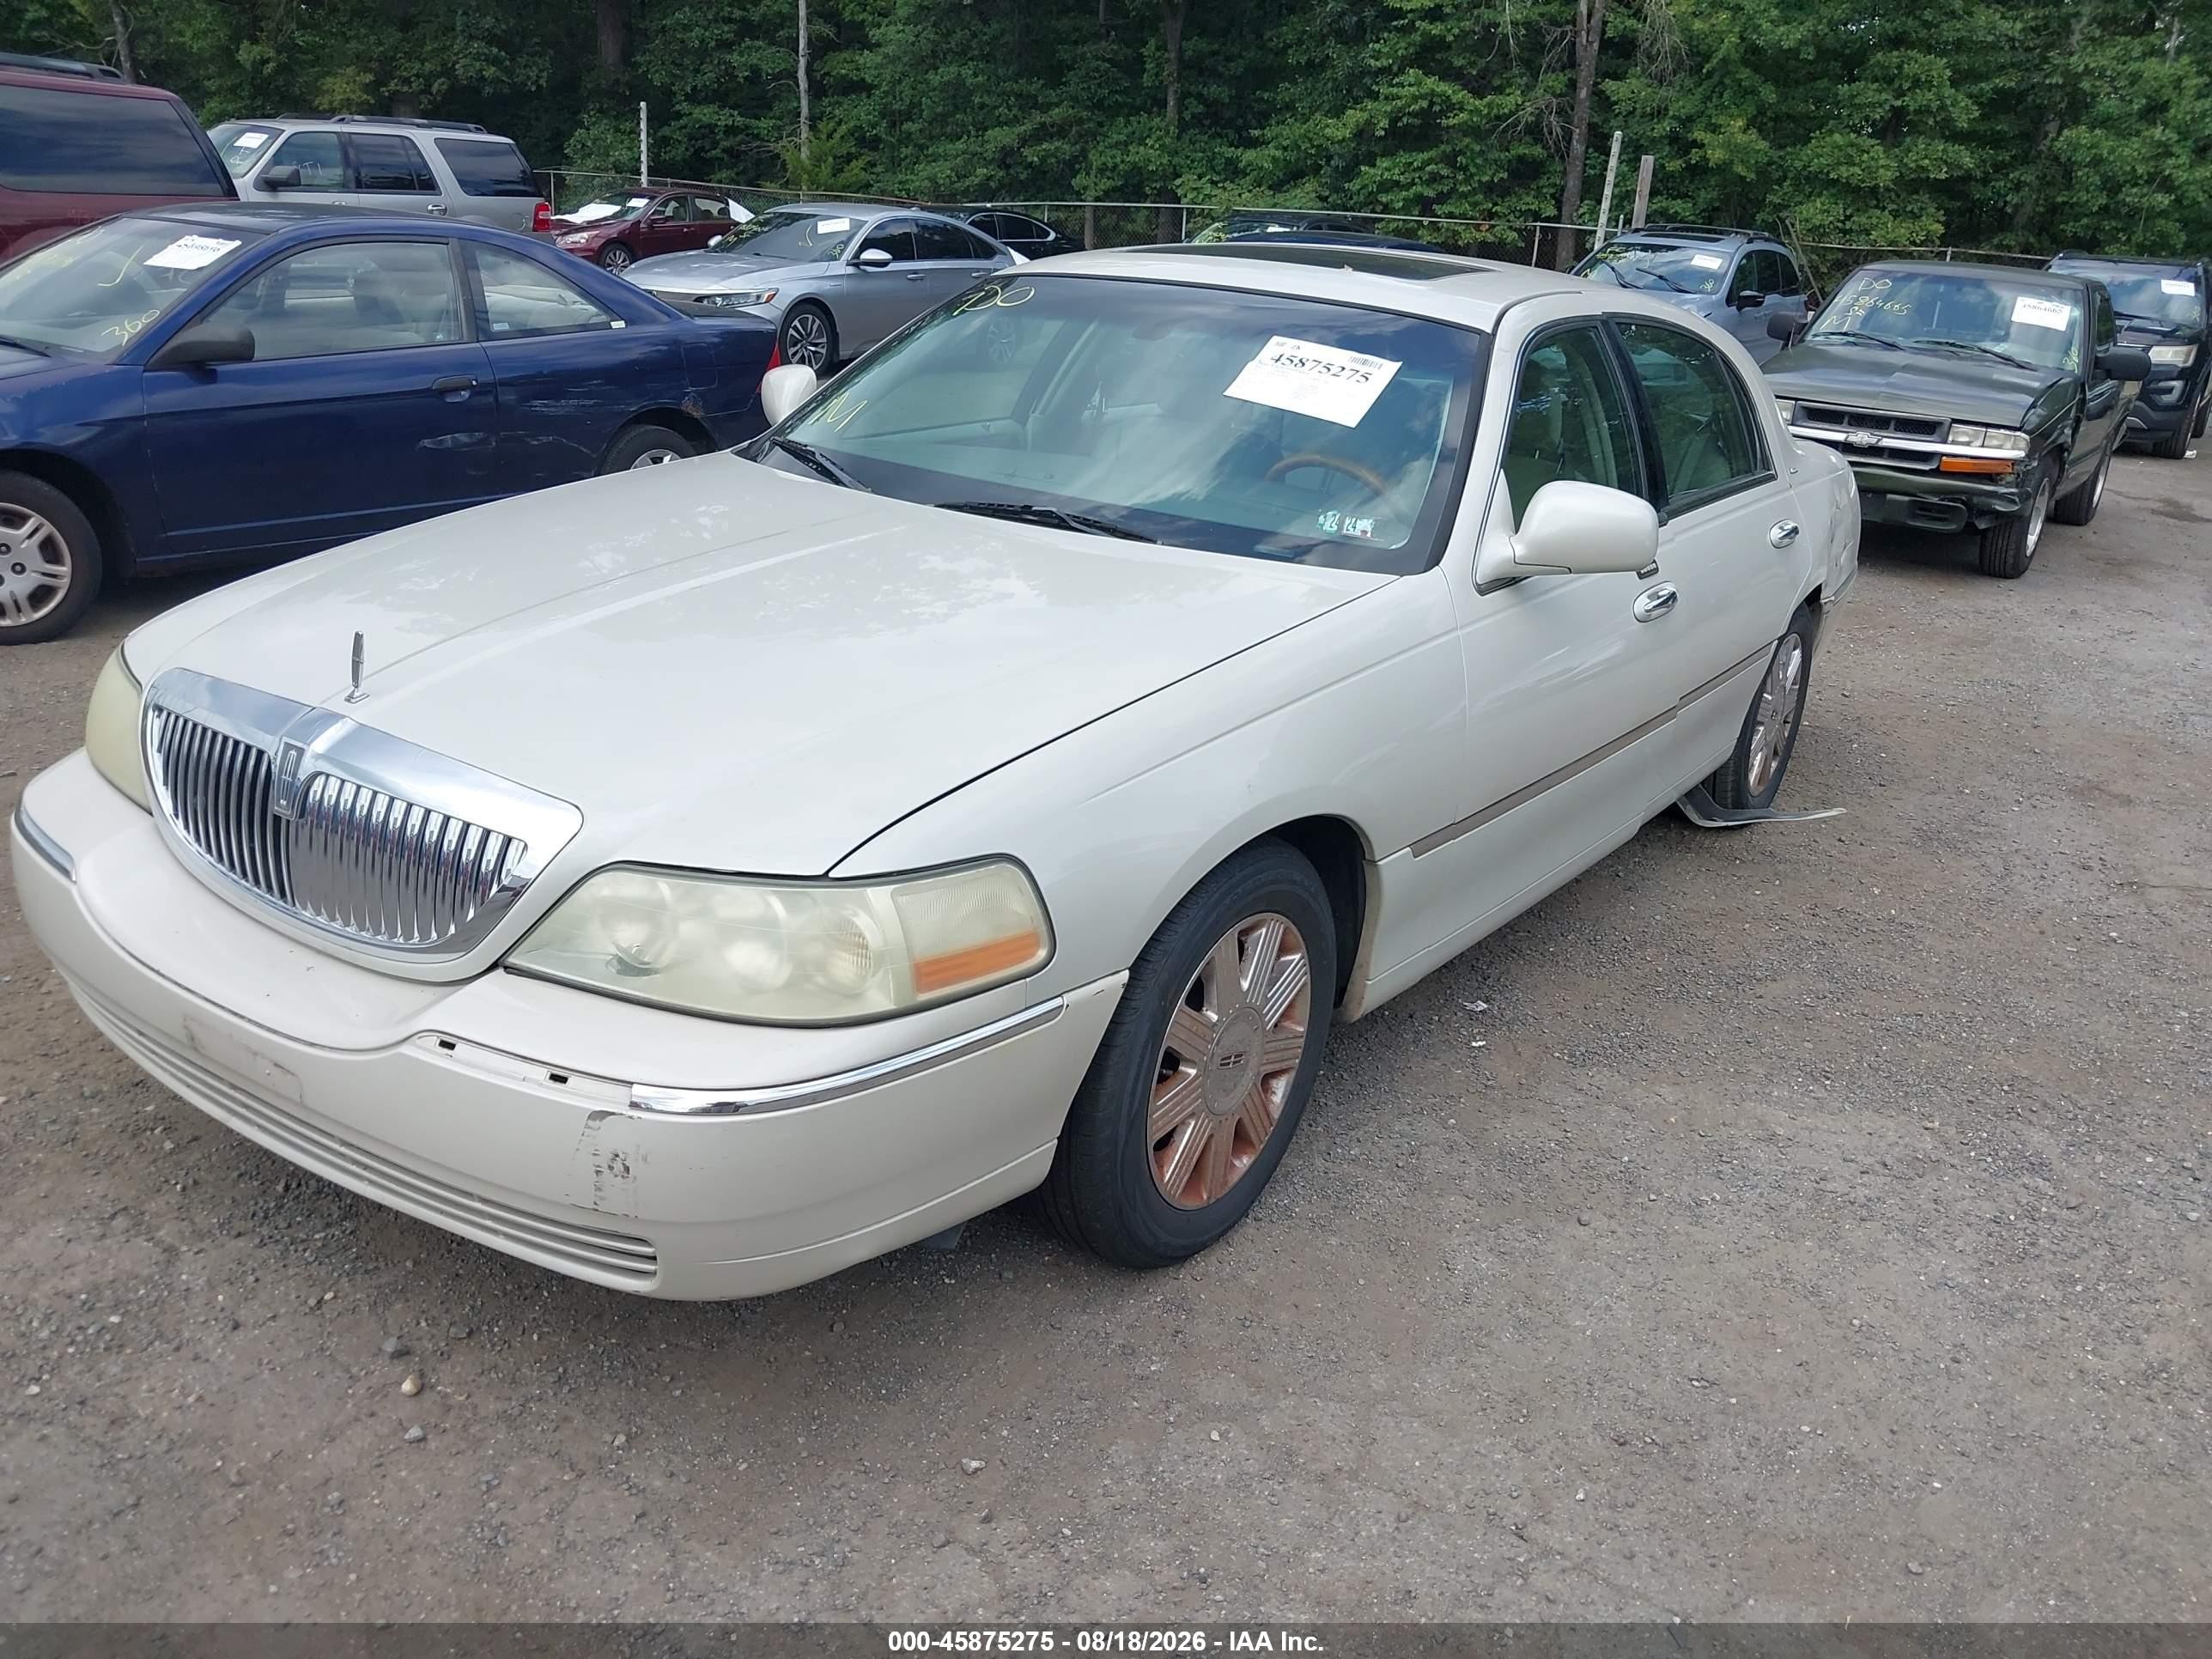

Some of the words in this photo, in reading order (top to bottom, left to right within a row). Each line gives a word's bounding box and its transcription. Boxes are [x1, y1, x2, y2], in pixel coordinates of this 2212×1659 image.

[1858, 277, 1893, 292] DO
[100, 309, 161, 346] 360
[1270, 353, 1374, 385] 45875275
